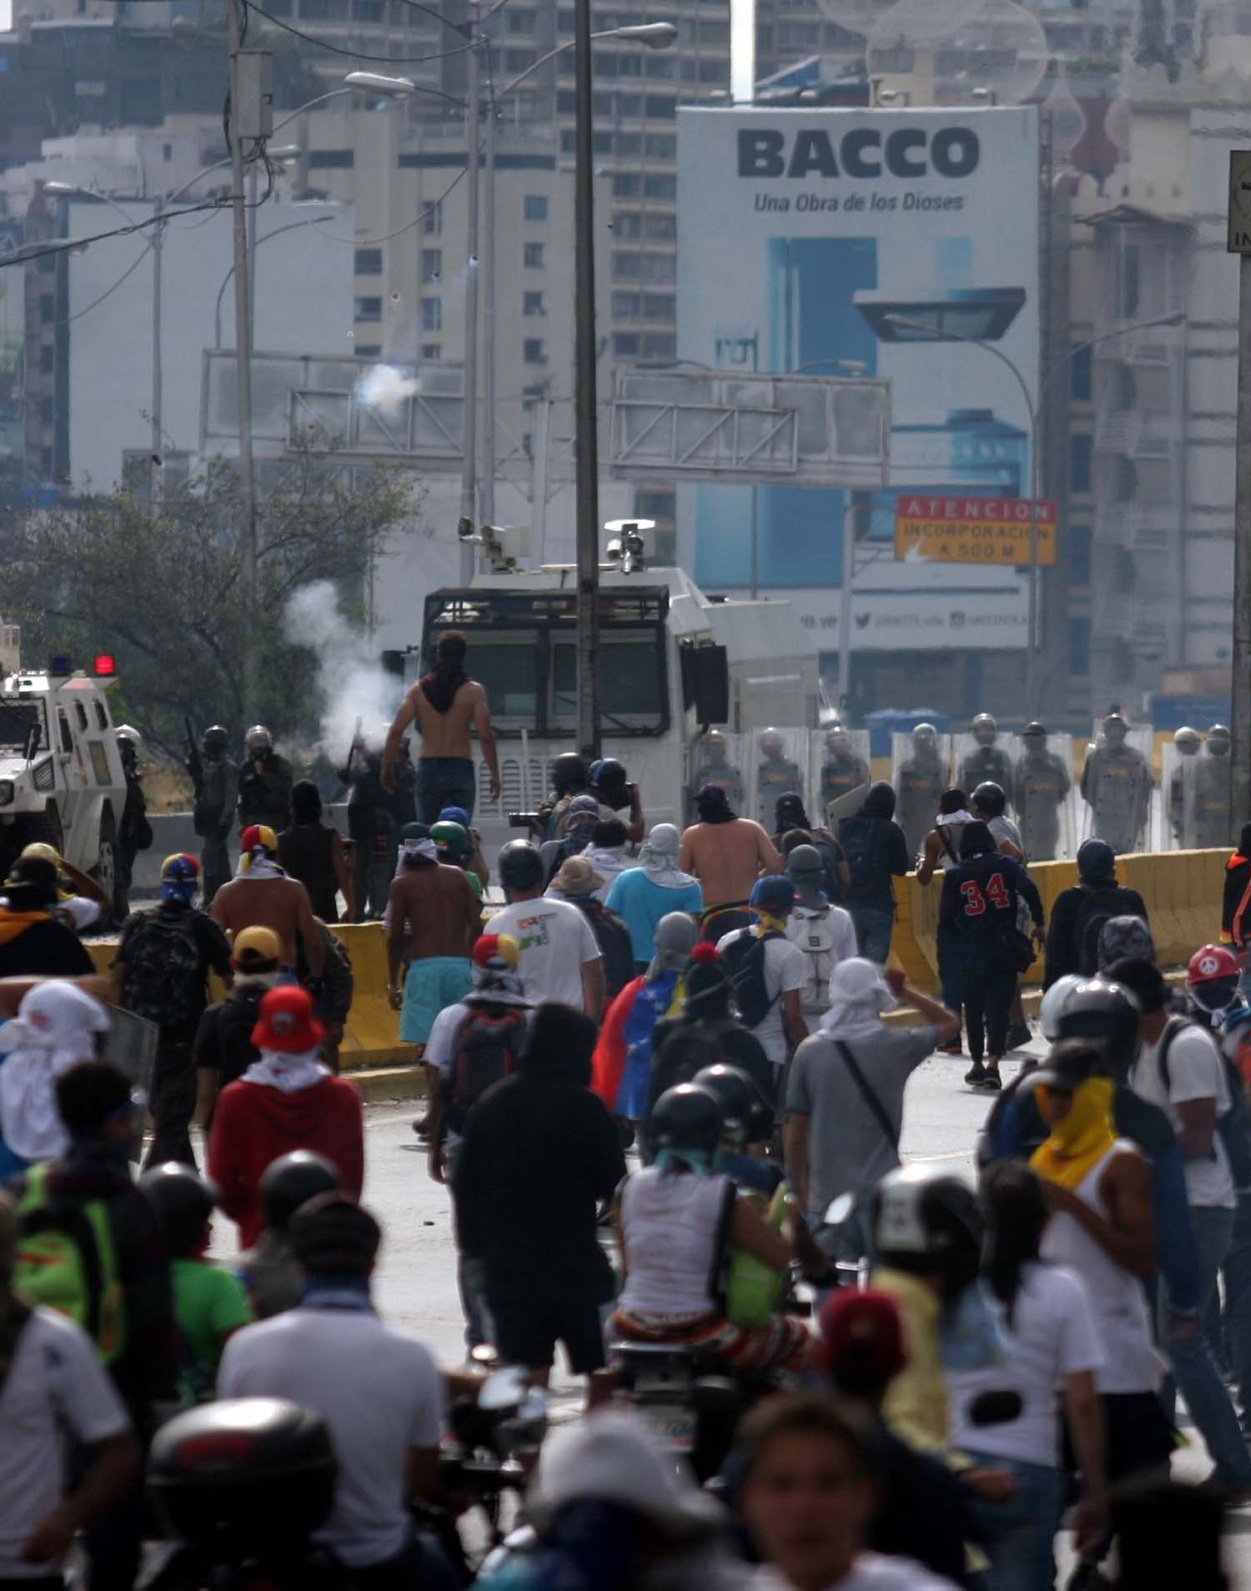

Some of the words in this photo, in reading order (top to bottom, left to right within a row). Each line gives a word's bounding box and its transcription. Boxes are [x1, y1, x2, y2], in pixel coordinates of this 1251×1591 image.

[737, 127, 981, 179] BACCO
[754, 193, 790, 214] Una
[796, 193, 839, 213] Obra
[843, 193, 865, 213] de
[869, 191, 897, 212] los
[902, 191, 965, 212] Dioses
[907, 501, 1047, 520] ATENCION
[960, 872, 1010, 916] 34
